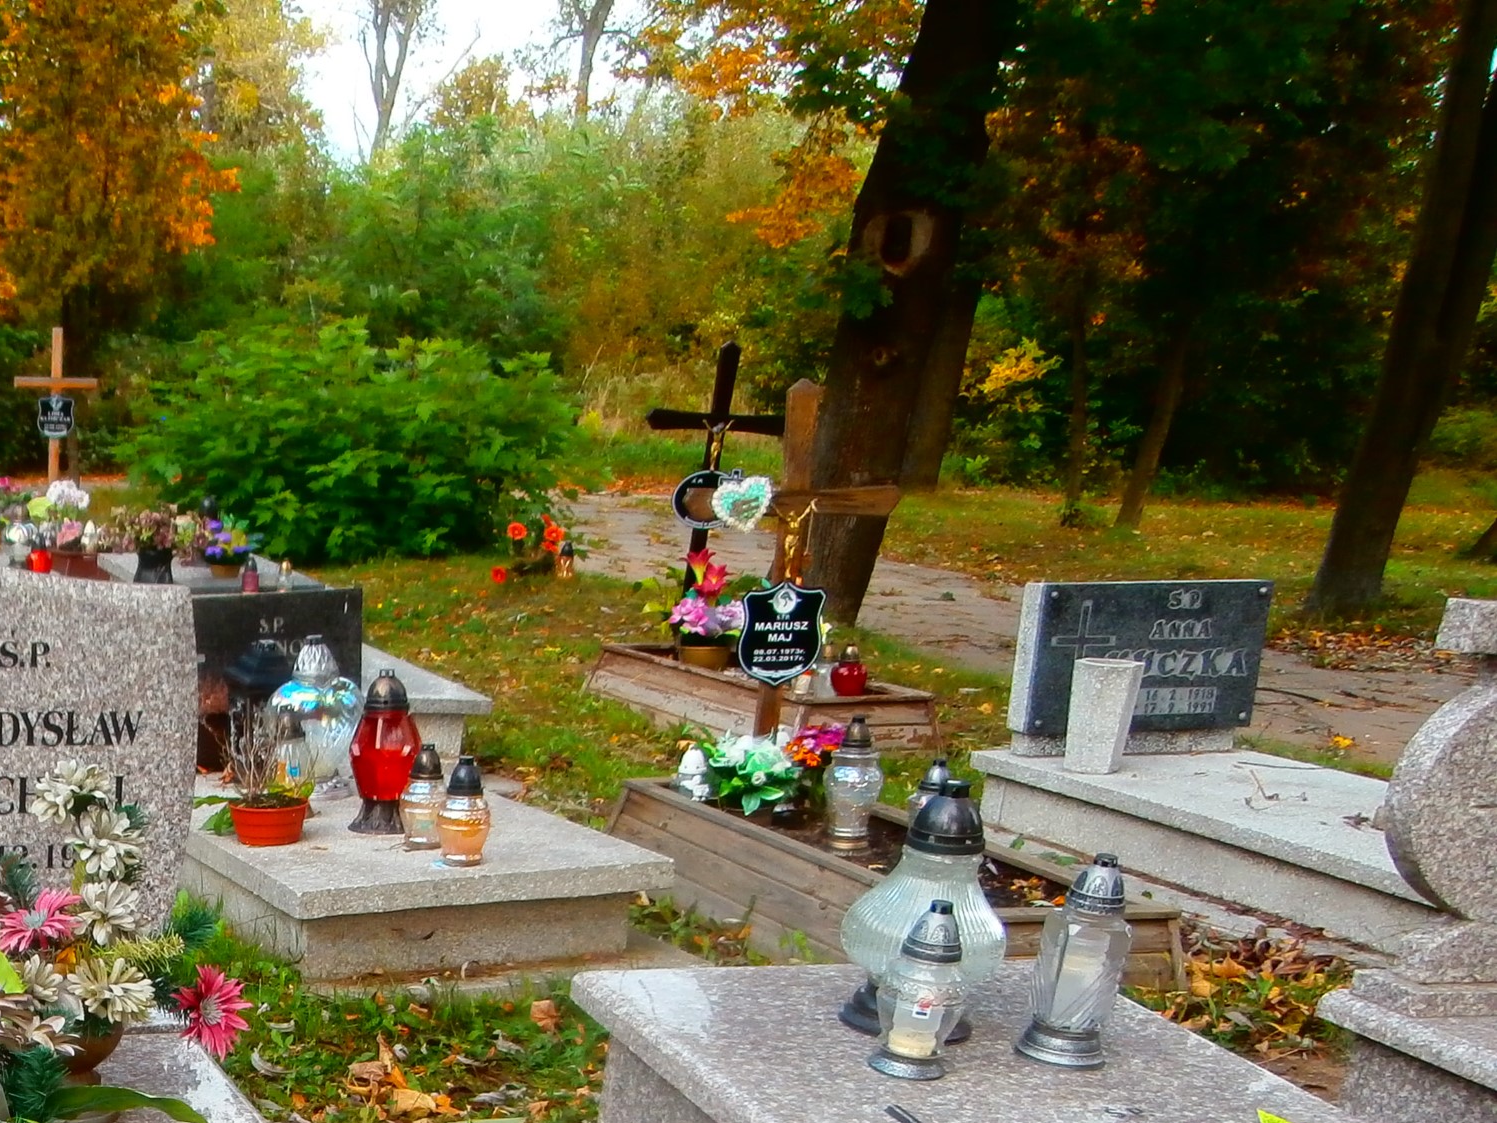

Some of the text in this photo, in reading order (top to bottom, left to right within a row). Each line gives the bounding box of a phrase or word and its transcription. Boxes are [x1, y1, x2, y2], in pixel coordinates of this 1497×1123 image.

[754, 621, 809, 632] MARIUSZ
[1148, 618, 1213, 640] ANNA
[767, 633, 793, 643] MAJ
